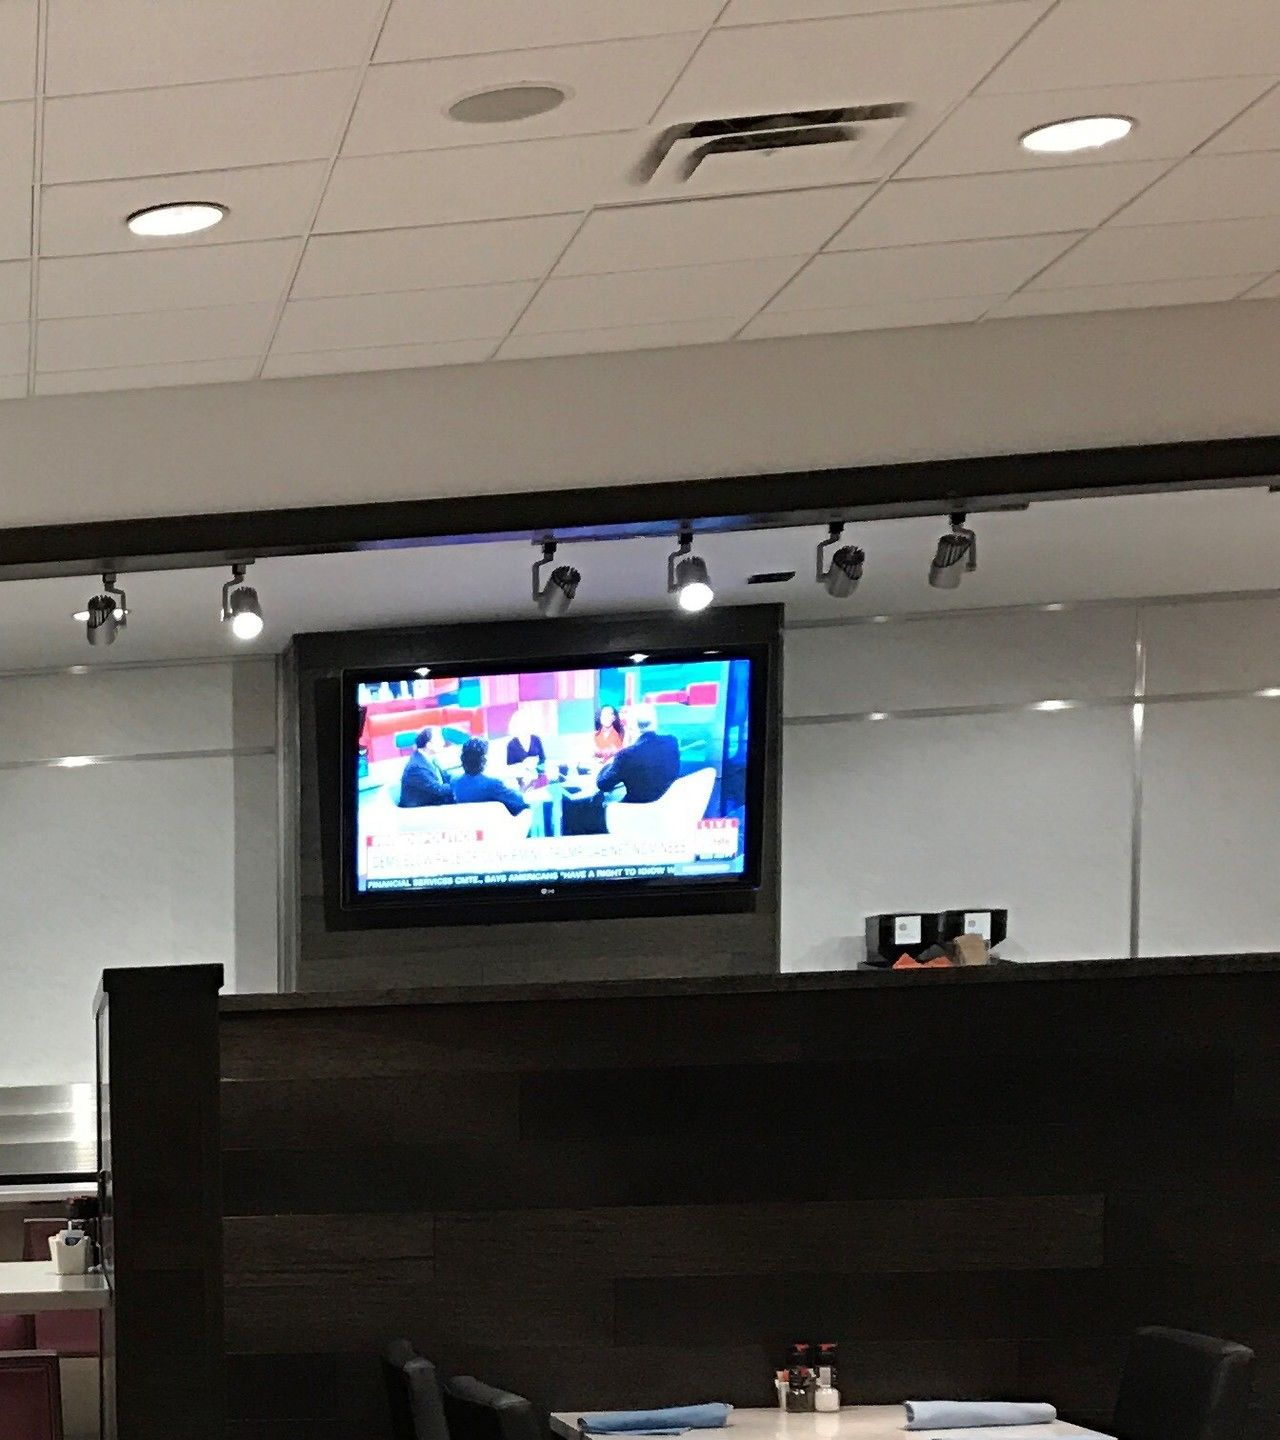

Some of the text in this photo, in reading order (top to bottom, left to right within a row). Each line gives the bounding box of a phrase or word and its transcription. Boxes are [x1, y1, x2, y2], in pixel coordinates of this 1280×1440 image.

[368, 879, 412, 889] FINANCIAL
[413, 877, 453, 887] SERVICES
[484, 874, 507, 883] SAYS
[508, 871, 559, 882] AMERICANS
[588, 869, 595, 878] A
[596, 868, 623, 877] RIGHT
[624, 868, 636, 876] TO
[637, 867, 666, 876] KNOW
